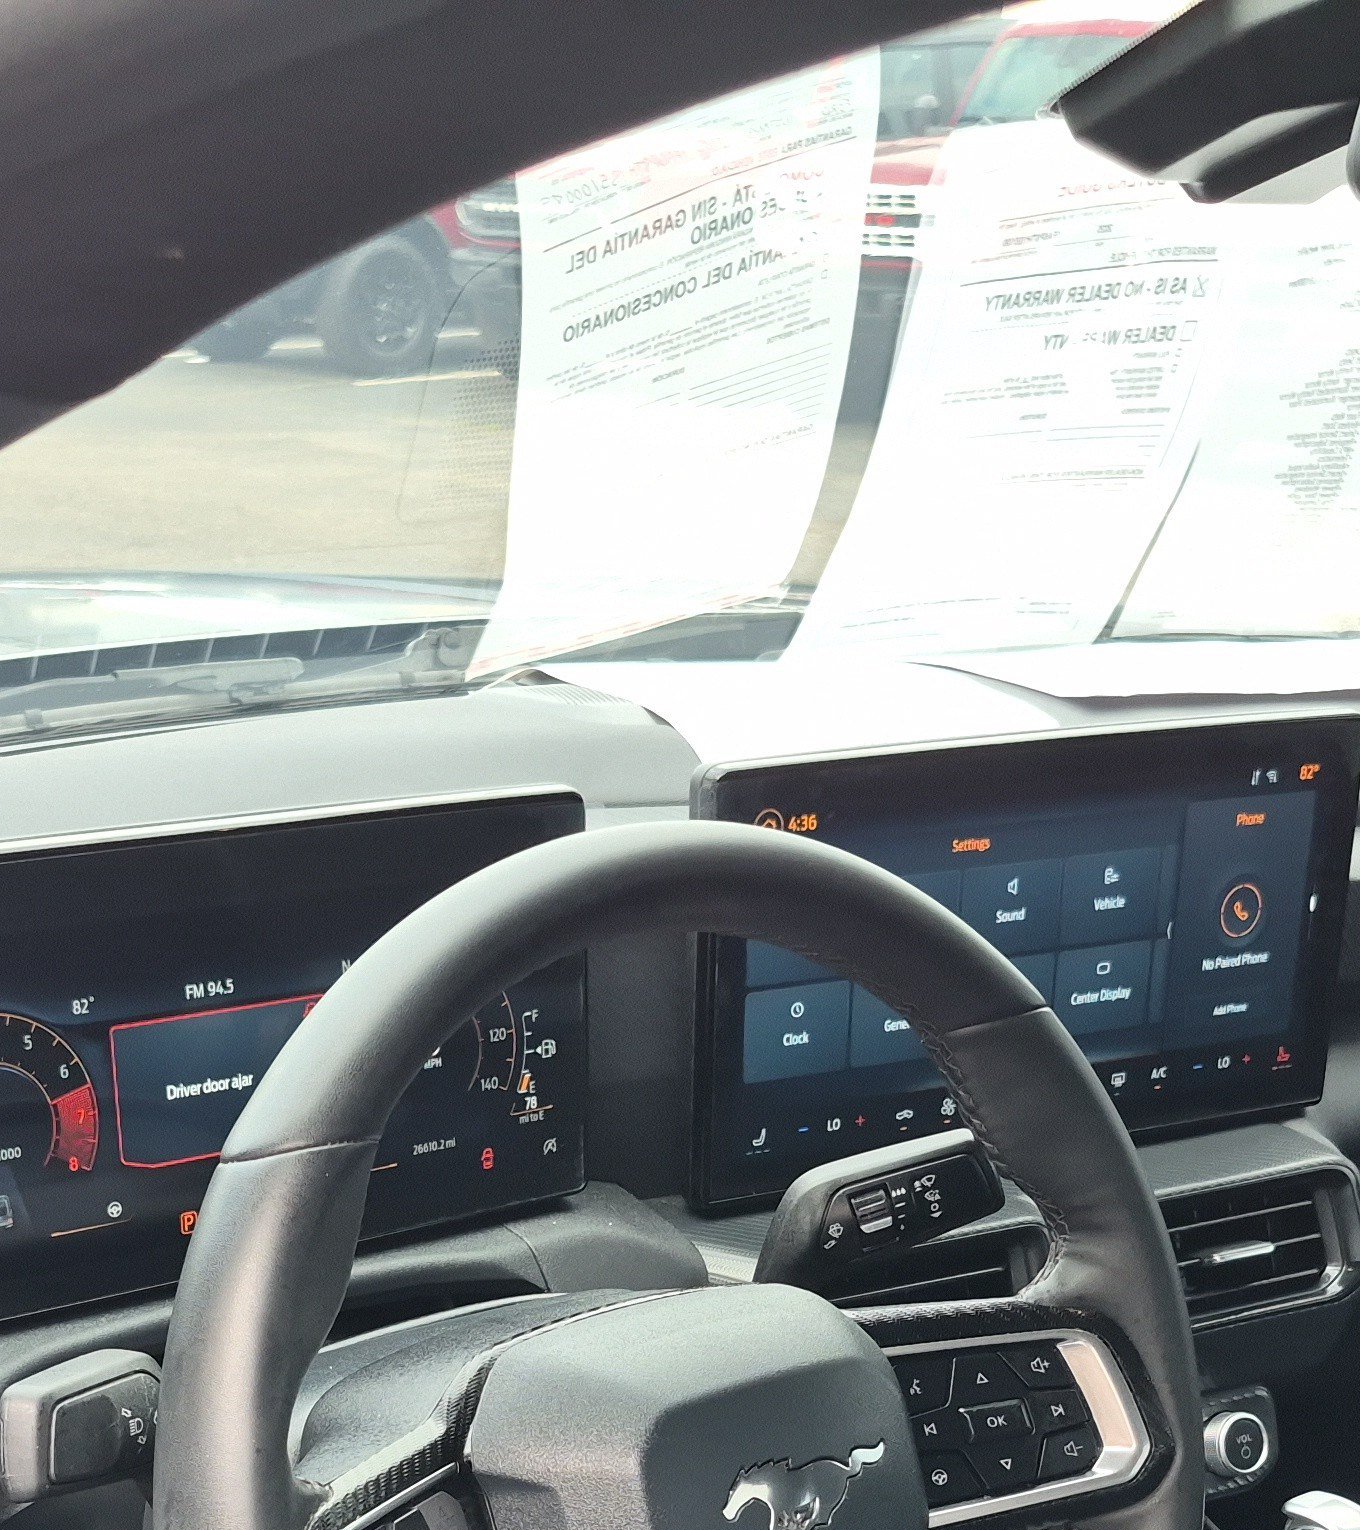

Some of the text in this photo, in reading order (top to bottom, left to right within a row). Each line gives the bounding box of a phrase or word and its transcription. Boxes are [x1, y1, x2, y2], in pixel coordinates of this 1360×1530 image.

[788, 813, 818, 832] 4:36
[1236, 811, 1267, 827] Phone
[951, 836, 991, 854] Settings
[1093, 894, 1126, 912] Vehicle
[995, 906, 1027, 924] Sound
[1201, 950, 1270, 972] No Paired Phone
[185, 977, 235, 1000] FM 94.5
[1070, 985, 1132, 1007] Center Display
[531, 1009, 539, 1022] F
[1212, 1002, 1249, 1017] Add Phone
[489, 1027, 507, 1042] 120
[782, 1030, 809, 1047] Clock
[23, 1036, 33, 1050] 5
[59, 1064, 69, 1079] 6
[1151, 1065, 1168, 1080] A/C
[166, 1073, 254, 1101] Driver door ajar
[480, 1076, 499, 1091] 140
[529, 1081, 536, 1093] E
[524, 1095, 538, 1110] 78
[76, 1110, 85, 1125] 7
[68, 1157, 79, 1171] 8
[986, 1414, 1008, 1429] OK
[1236, 1433, 1253, 1444] VOL
